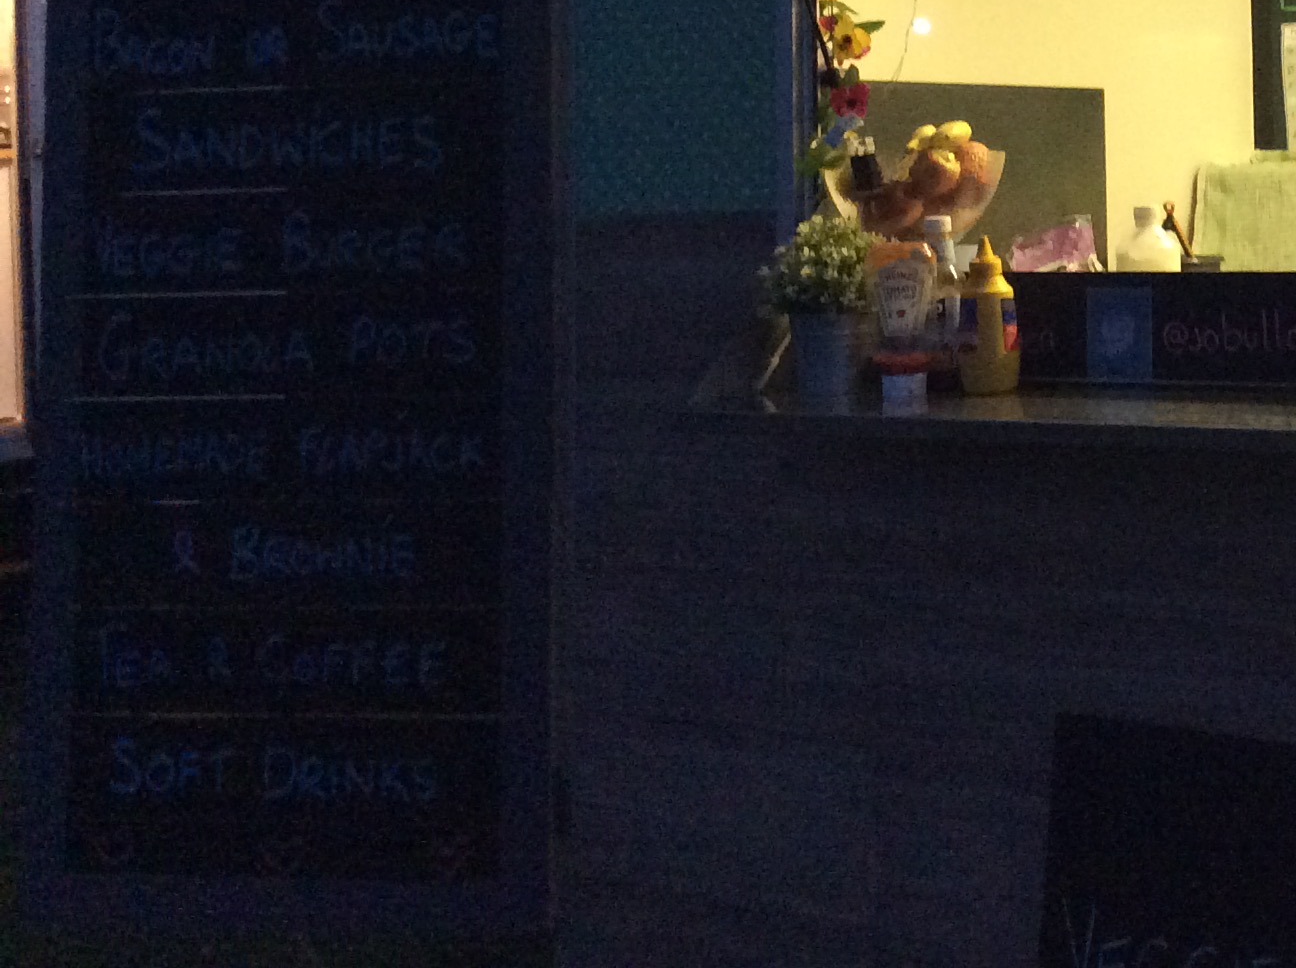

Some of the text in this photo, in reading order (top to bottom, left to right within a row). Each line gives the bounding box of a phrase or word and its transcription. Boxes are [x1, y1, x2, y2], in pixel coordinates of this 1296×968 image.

[128, 106, 445, 173] SANDWICHES
[347, 314, 478, 368] POTS
[109, 737, 438, 802] SOFT DRINKS
